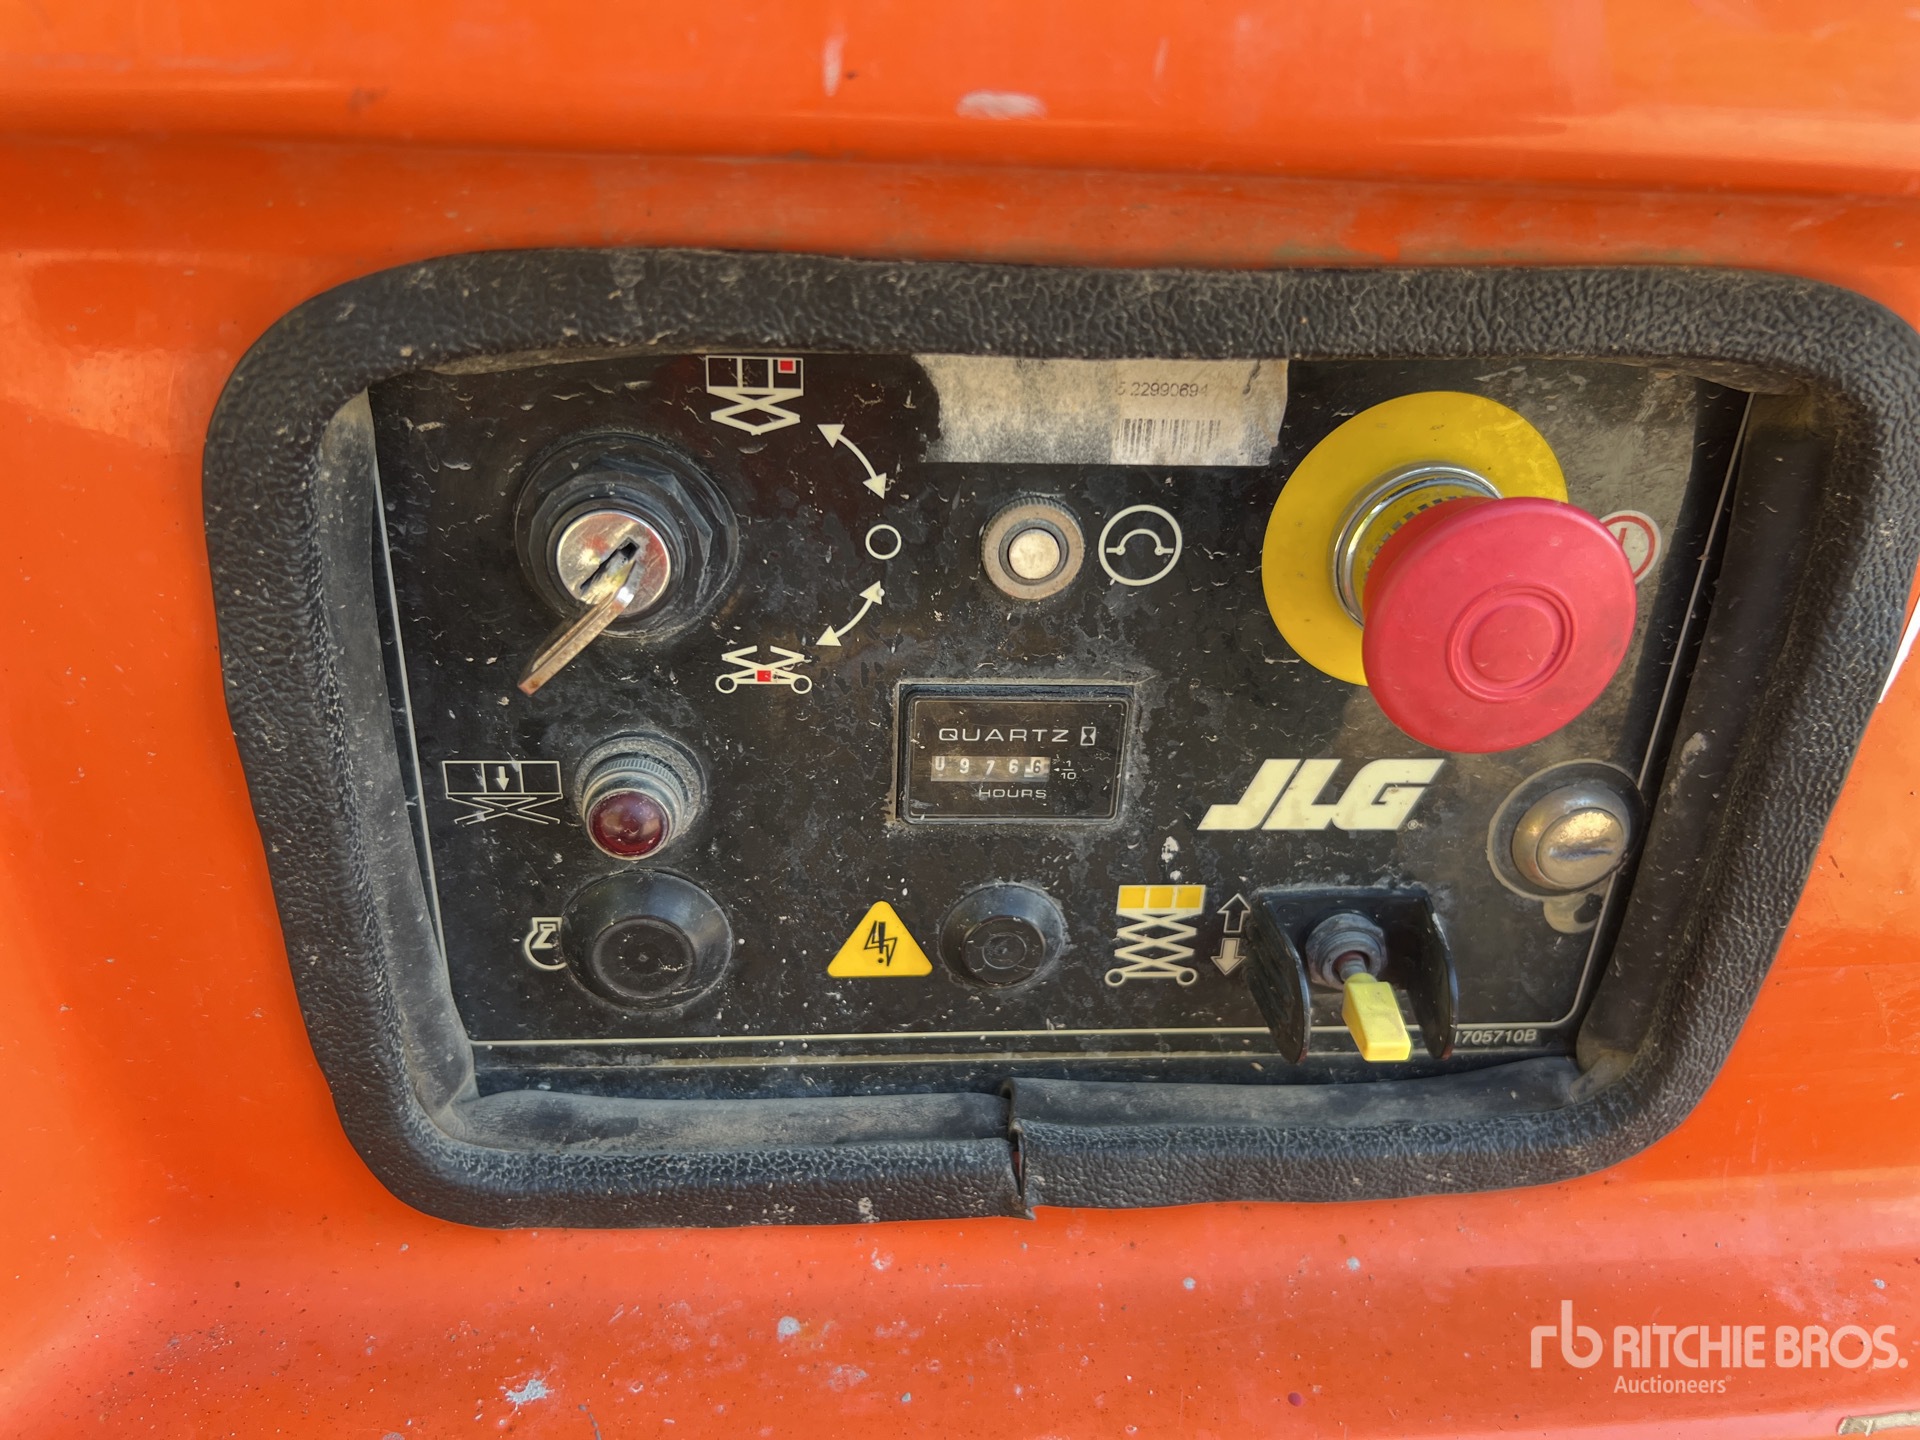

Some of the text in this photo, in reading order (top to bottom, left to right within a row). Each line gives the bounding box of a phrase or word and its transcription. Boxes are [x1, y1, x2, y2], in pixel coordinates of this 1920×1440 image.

[938, 728, 1069, 742] QUARTZ
[978, 789, 1047, 798] HOURS
[1196, 758, 1445, 831] JLG
[1454, 1028, 1537, 1044] 1705710B
